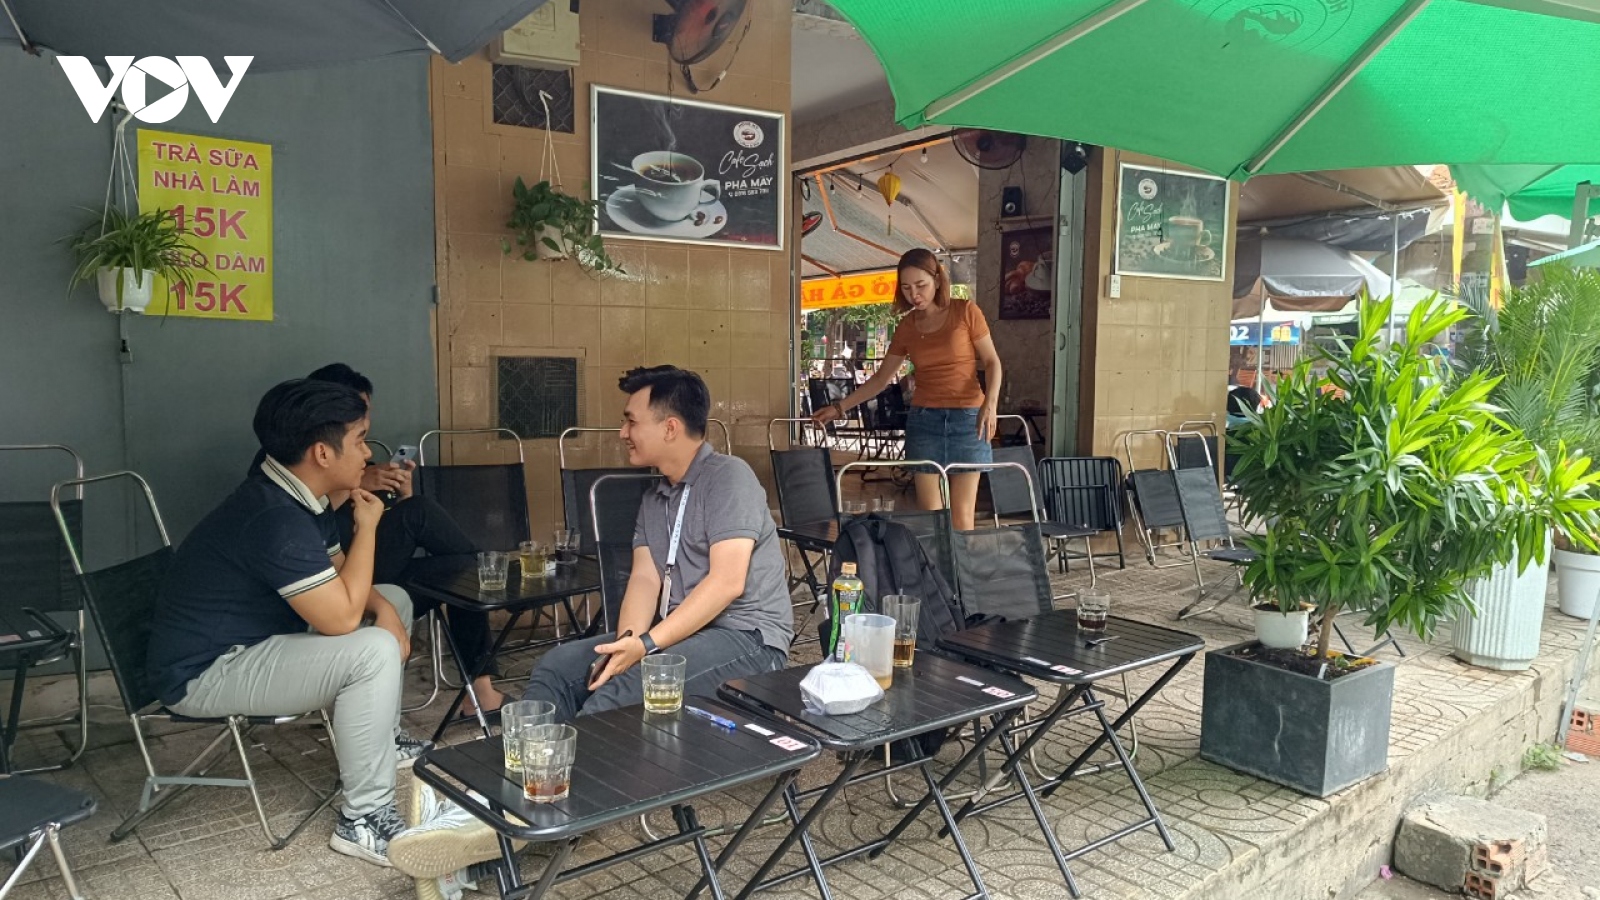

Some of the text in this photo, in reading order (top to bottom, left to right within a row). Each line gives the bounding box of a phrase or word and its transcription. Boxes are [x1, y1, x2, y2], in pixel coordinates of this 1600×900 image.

[152, 142, 259, 171] TRÀ SỮA
[154, 170, 260, 197] NHÀ LÀM
[724, 179, 748, 190] PHA
[169, 204, 247, 240] 15K
[170, 280, 248, 313] 15K
